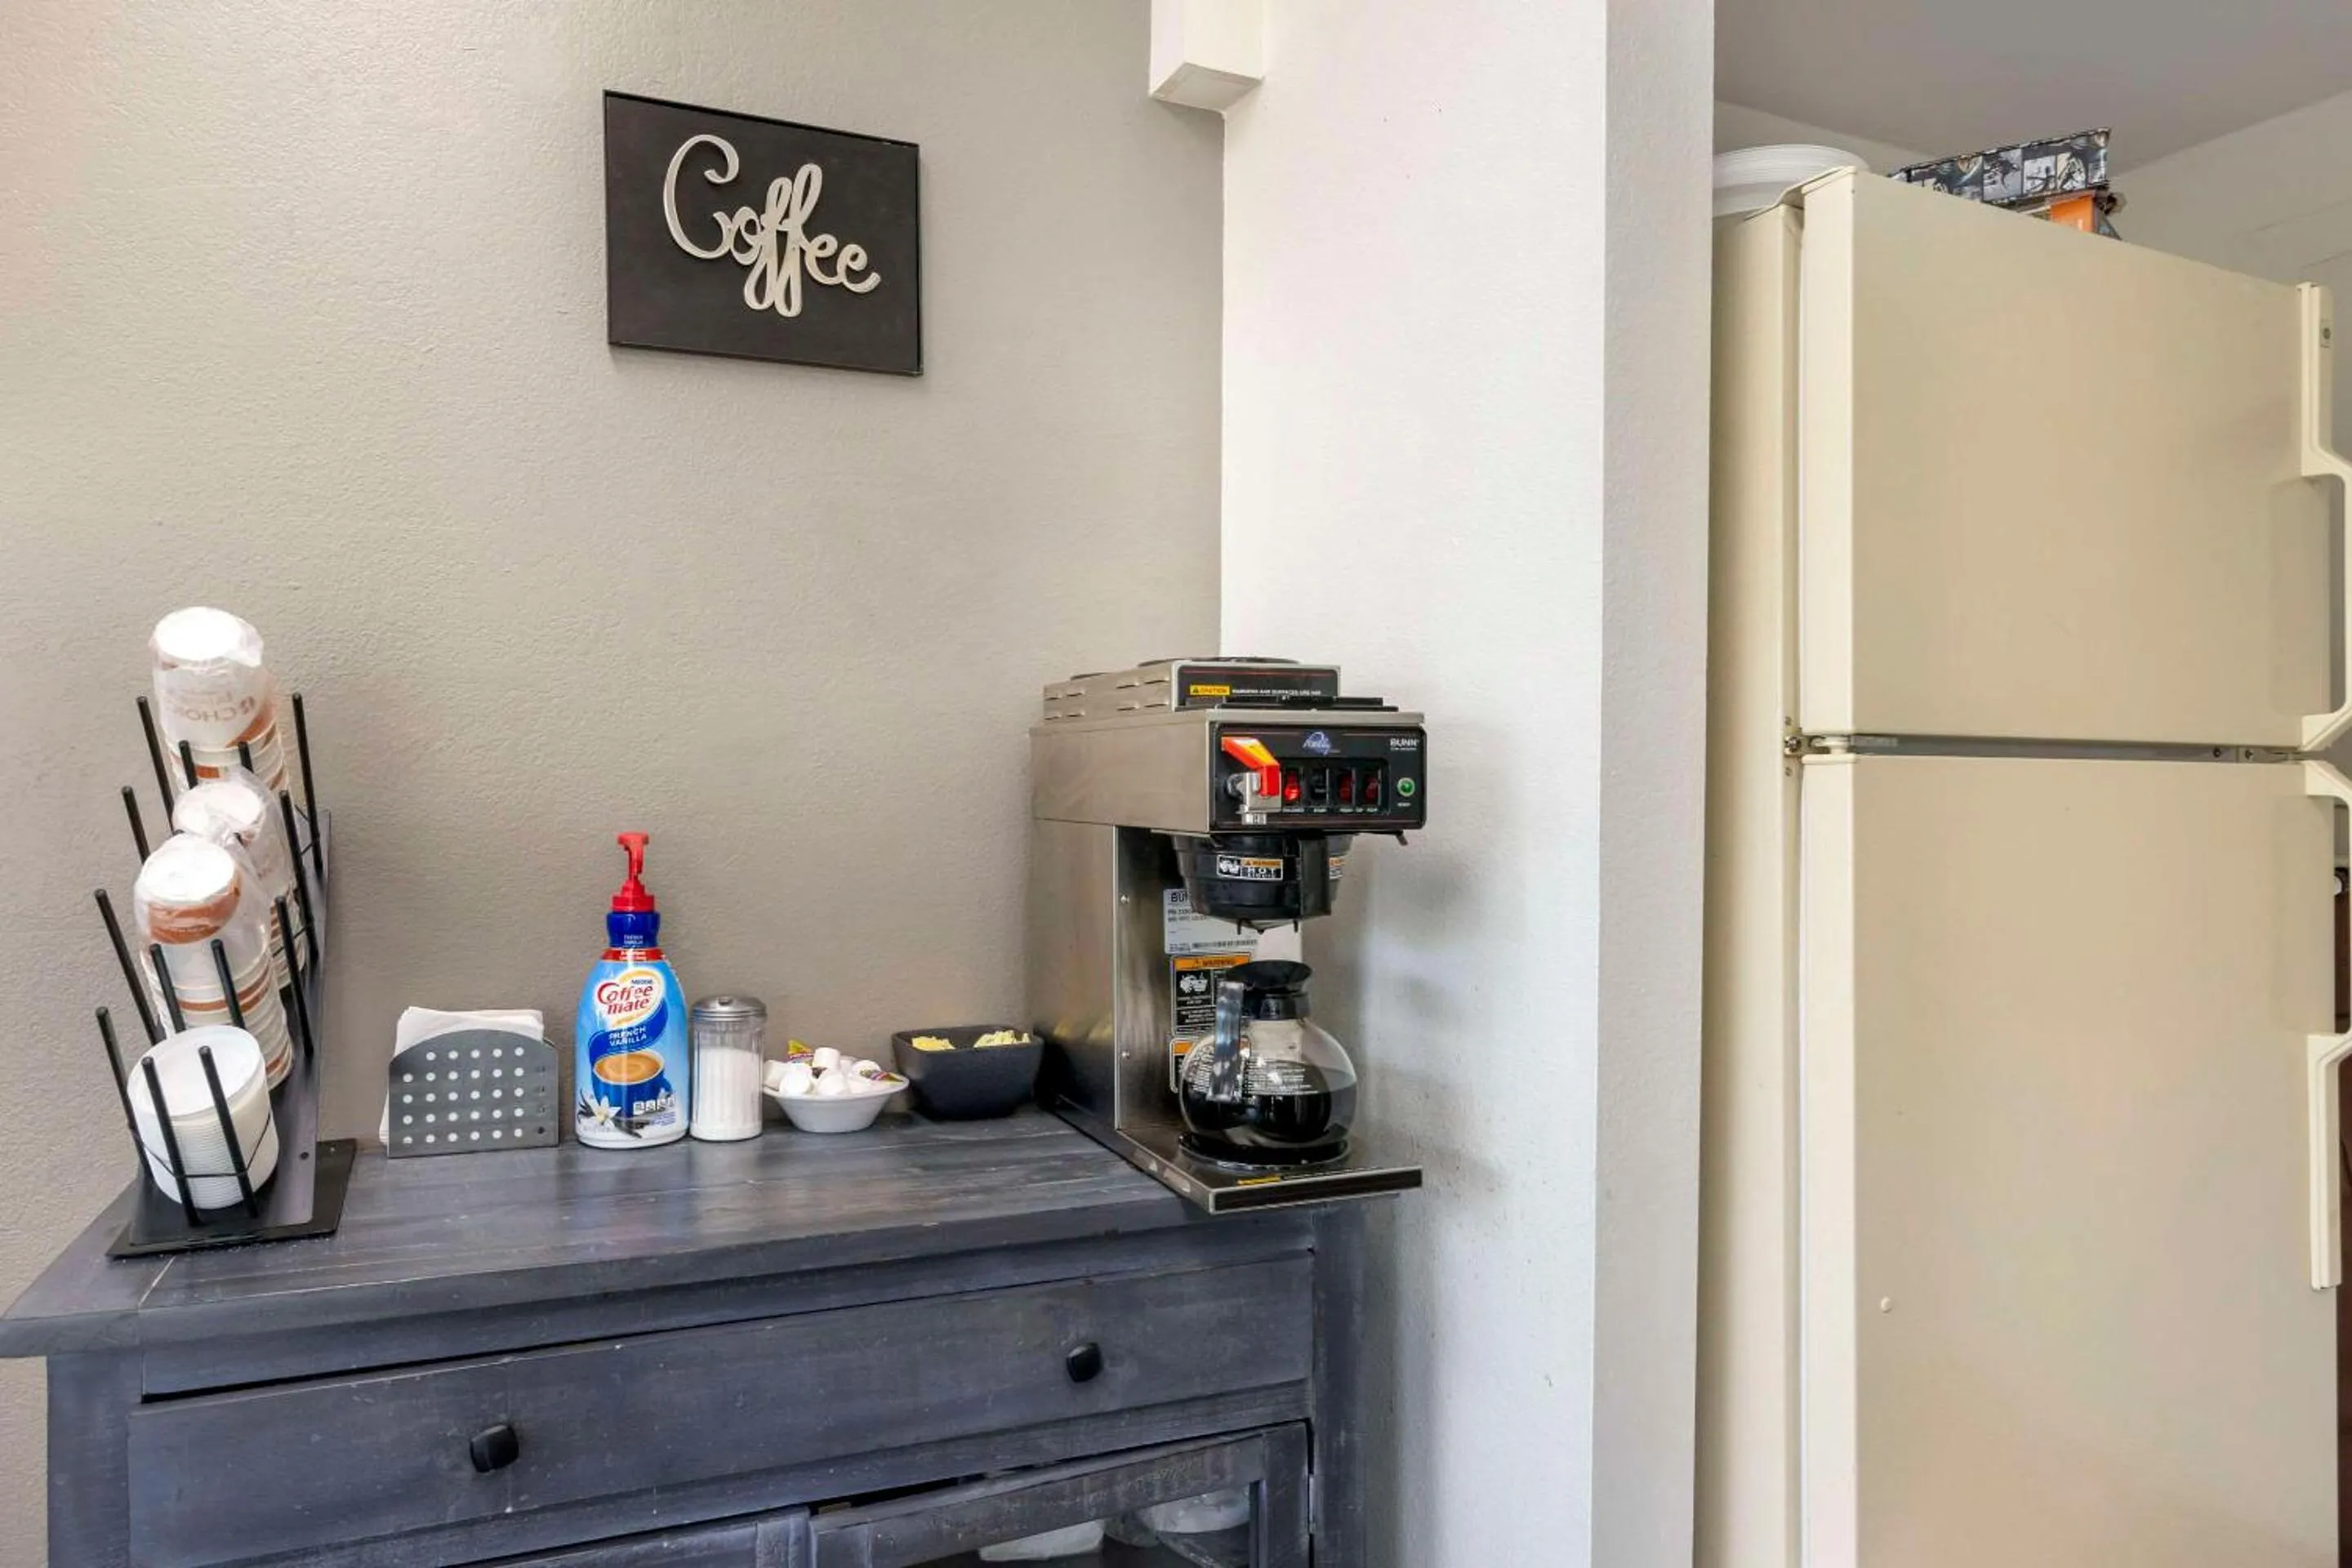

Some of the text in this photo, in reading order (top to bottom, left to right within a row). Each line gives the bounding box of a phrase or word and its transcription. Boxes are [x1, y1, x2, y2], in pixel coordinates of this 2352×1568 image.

[662, 134, 881, 318] Coffee
[1171, 892, 1187, 902] BU
[598, 982, 653, 1005] Coffee
[608, 997, 651, 1015] mate
[608, 1026, 647, 1040] FRENCH
[608, 1034, 648, 1046] VANILLA
